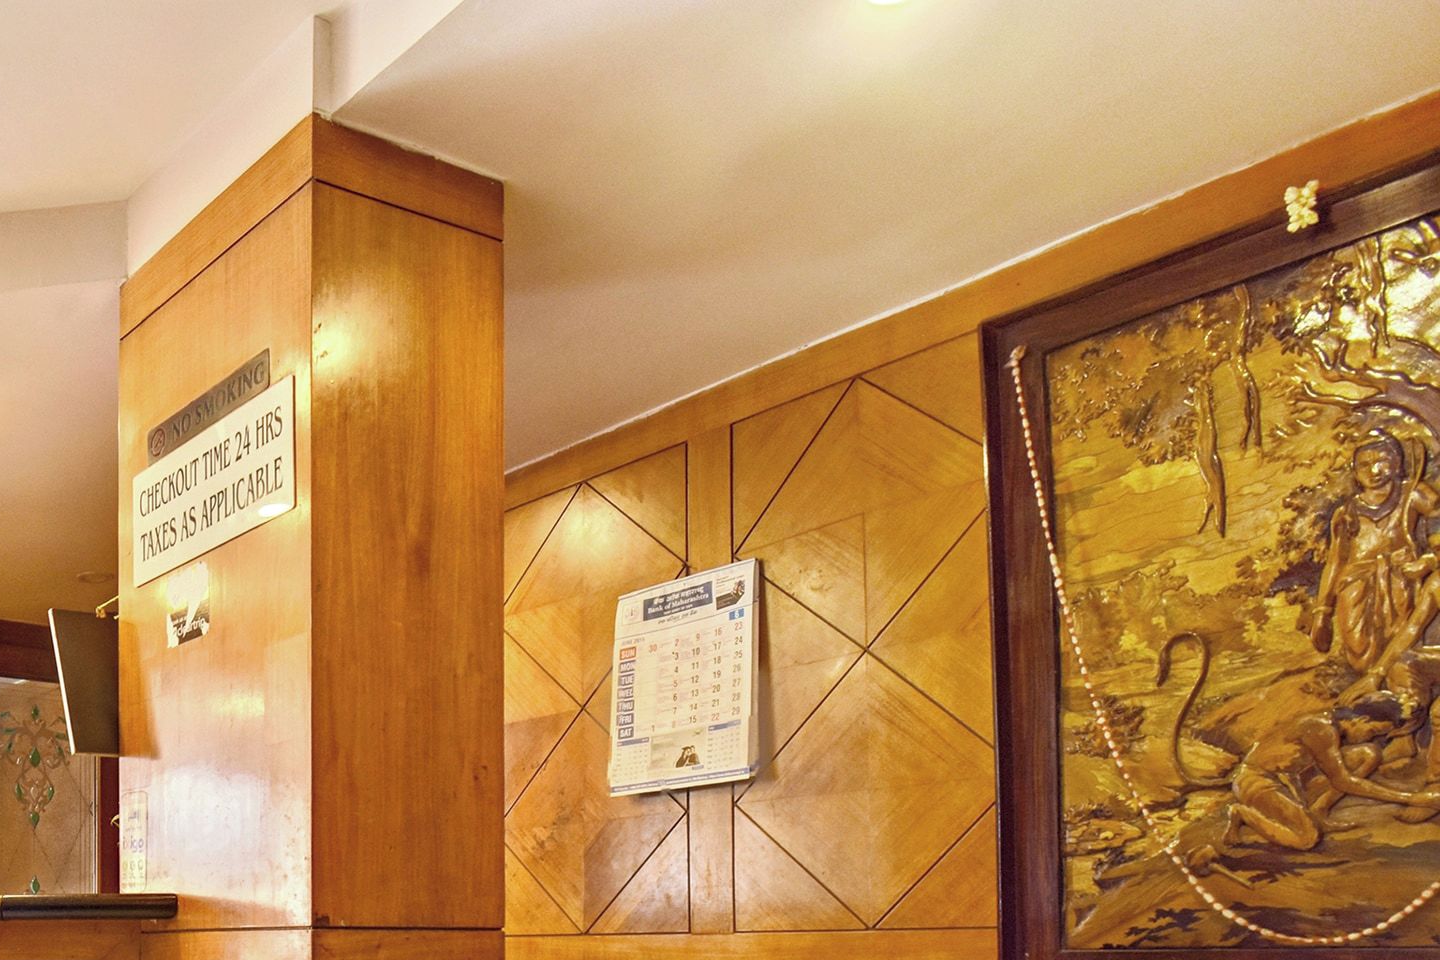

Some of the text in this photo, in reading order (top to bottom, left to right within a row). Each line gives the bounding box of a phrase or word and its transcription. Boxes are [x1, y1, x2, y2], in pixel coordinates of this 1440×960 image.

[172, 362, 264, 441] NO SMOKING
[139, 405, 284, 517] CHECKOUT TIME 24 HRS
[140, 456, 284, 562] TAXES AS APPLICABLE
[647, 604, 663, 614] Bank
[664, 602, 672, 610] of
[621, 648, 635, 659] SUN
[622, 675, 634, 685] TUE
[621, 714, 632, 725] FRI
[620, 727, 632, 738] SAT
